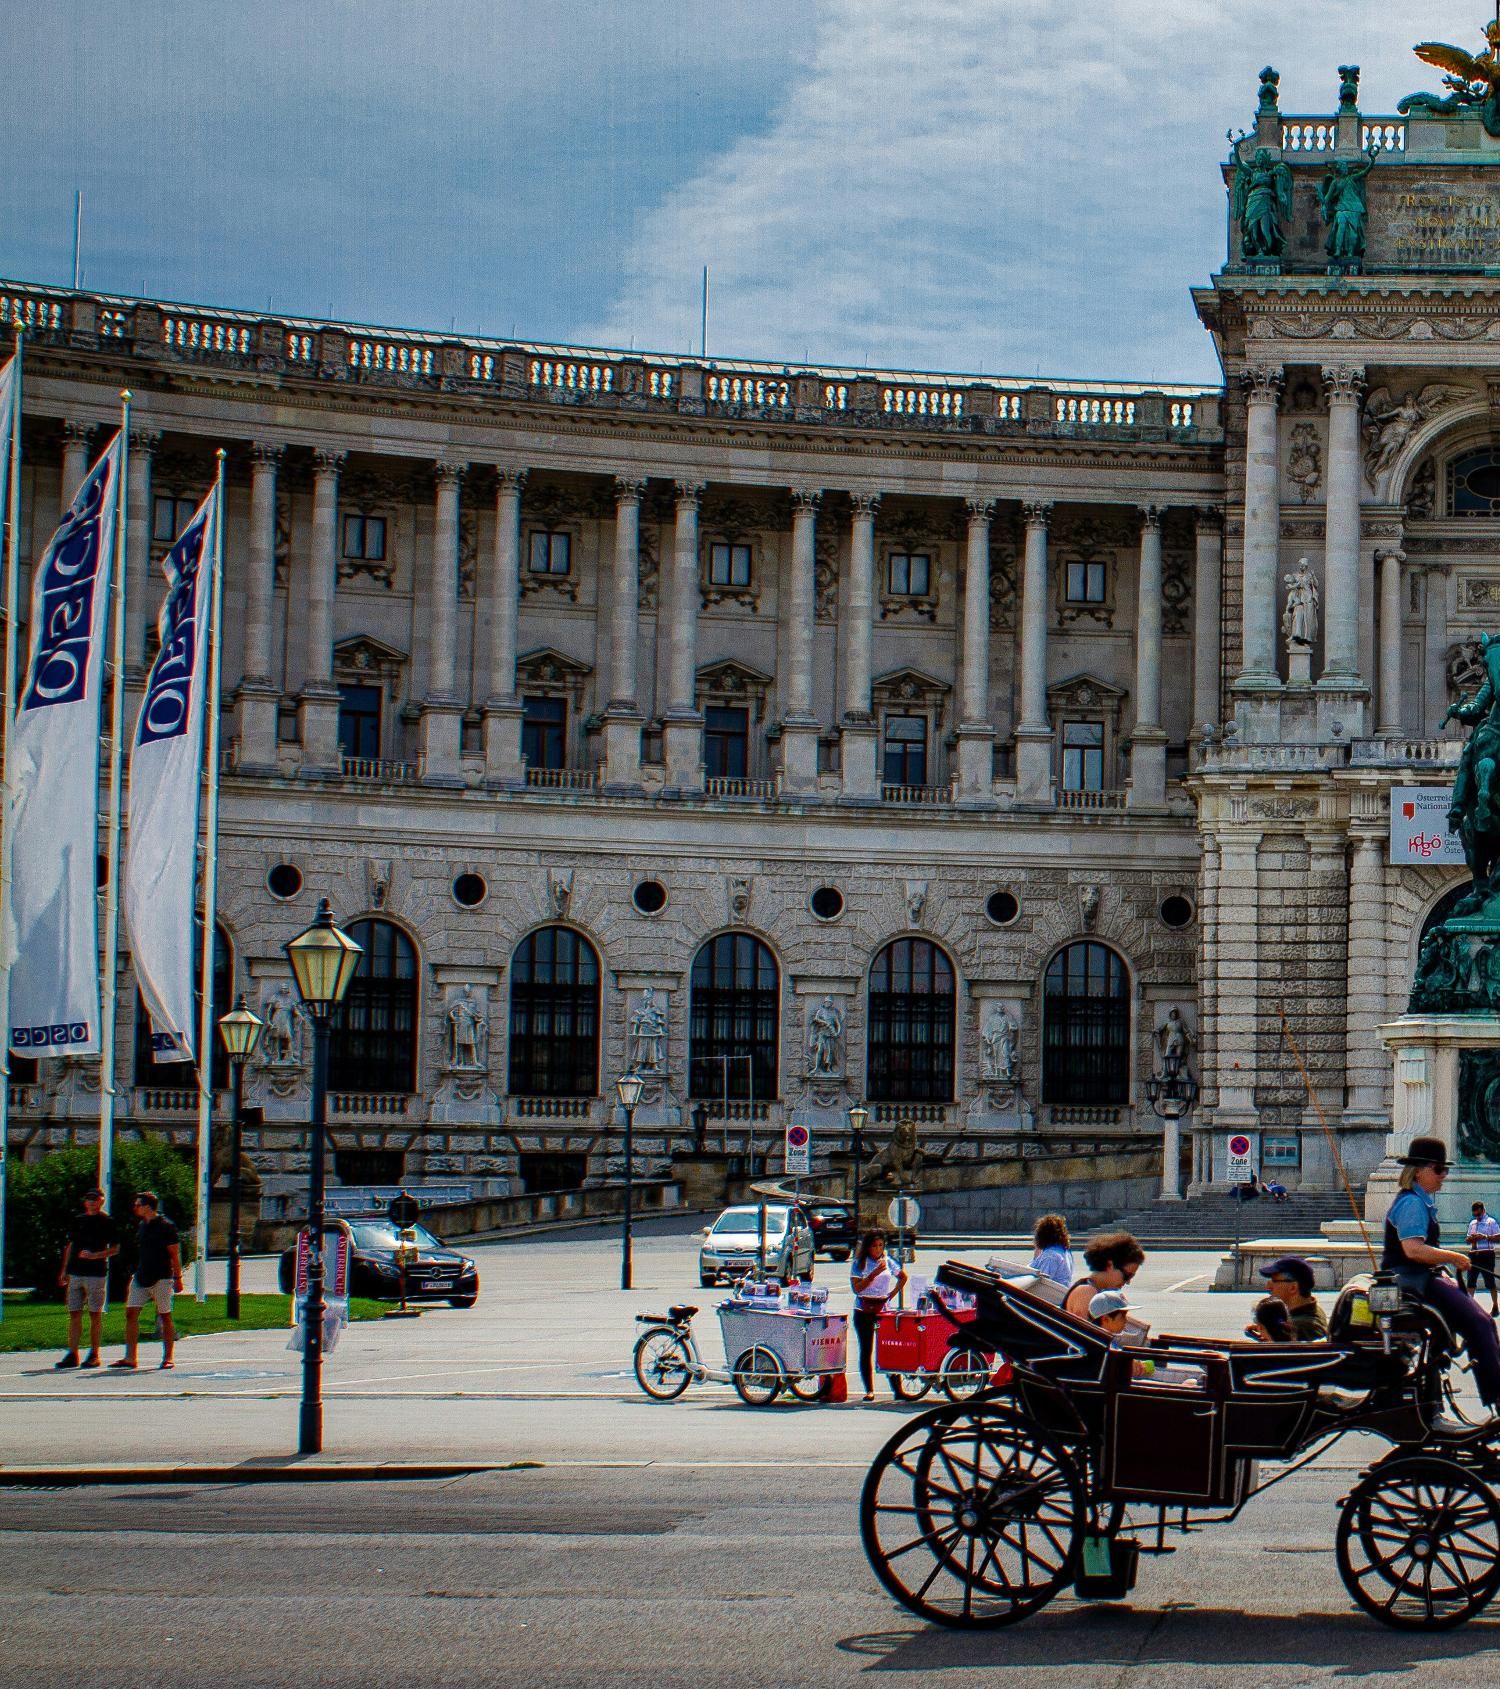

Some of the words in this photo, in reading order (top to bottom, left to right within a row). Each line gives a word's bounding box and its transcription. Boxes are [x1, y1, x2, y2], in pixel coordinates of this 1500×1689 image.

[1416, 793, 1452, 802] Österreic
[1416, 802, 1450, 810] National
[1231, 1156, 1248, 1165] Zone
[811, 1337, 841, 1346] VIENNA
